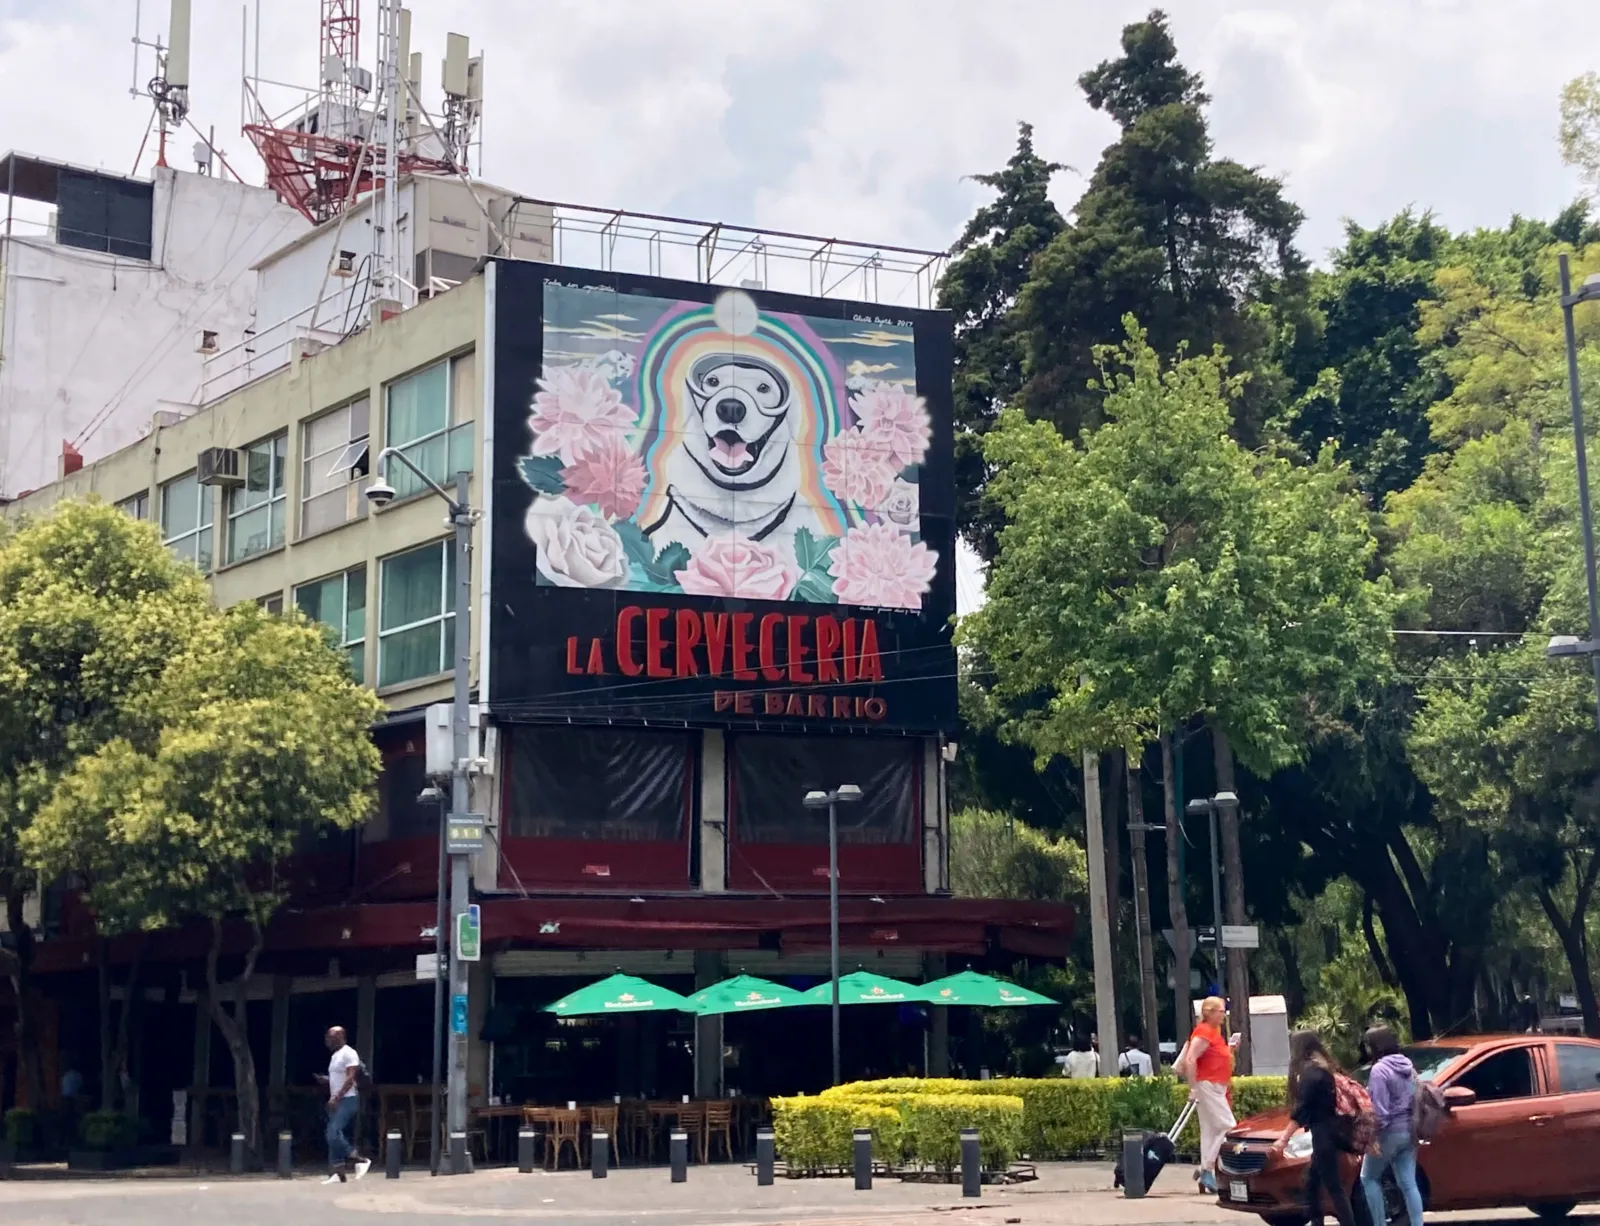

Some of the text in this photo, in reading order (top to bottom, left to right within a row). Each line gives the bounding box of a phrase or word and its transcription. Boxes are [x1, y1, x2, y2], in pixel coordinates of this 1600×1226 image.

[896, 319, 914, 327] 2017
[567, 606, 884, 684] LA CERVECERIA
[714, 690, 887, 720] DE BARRIO
